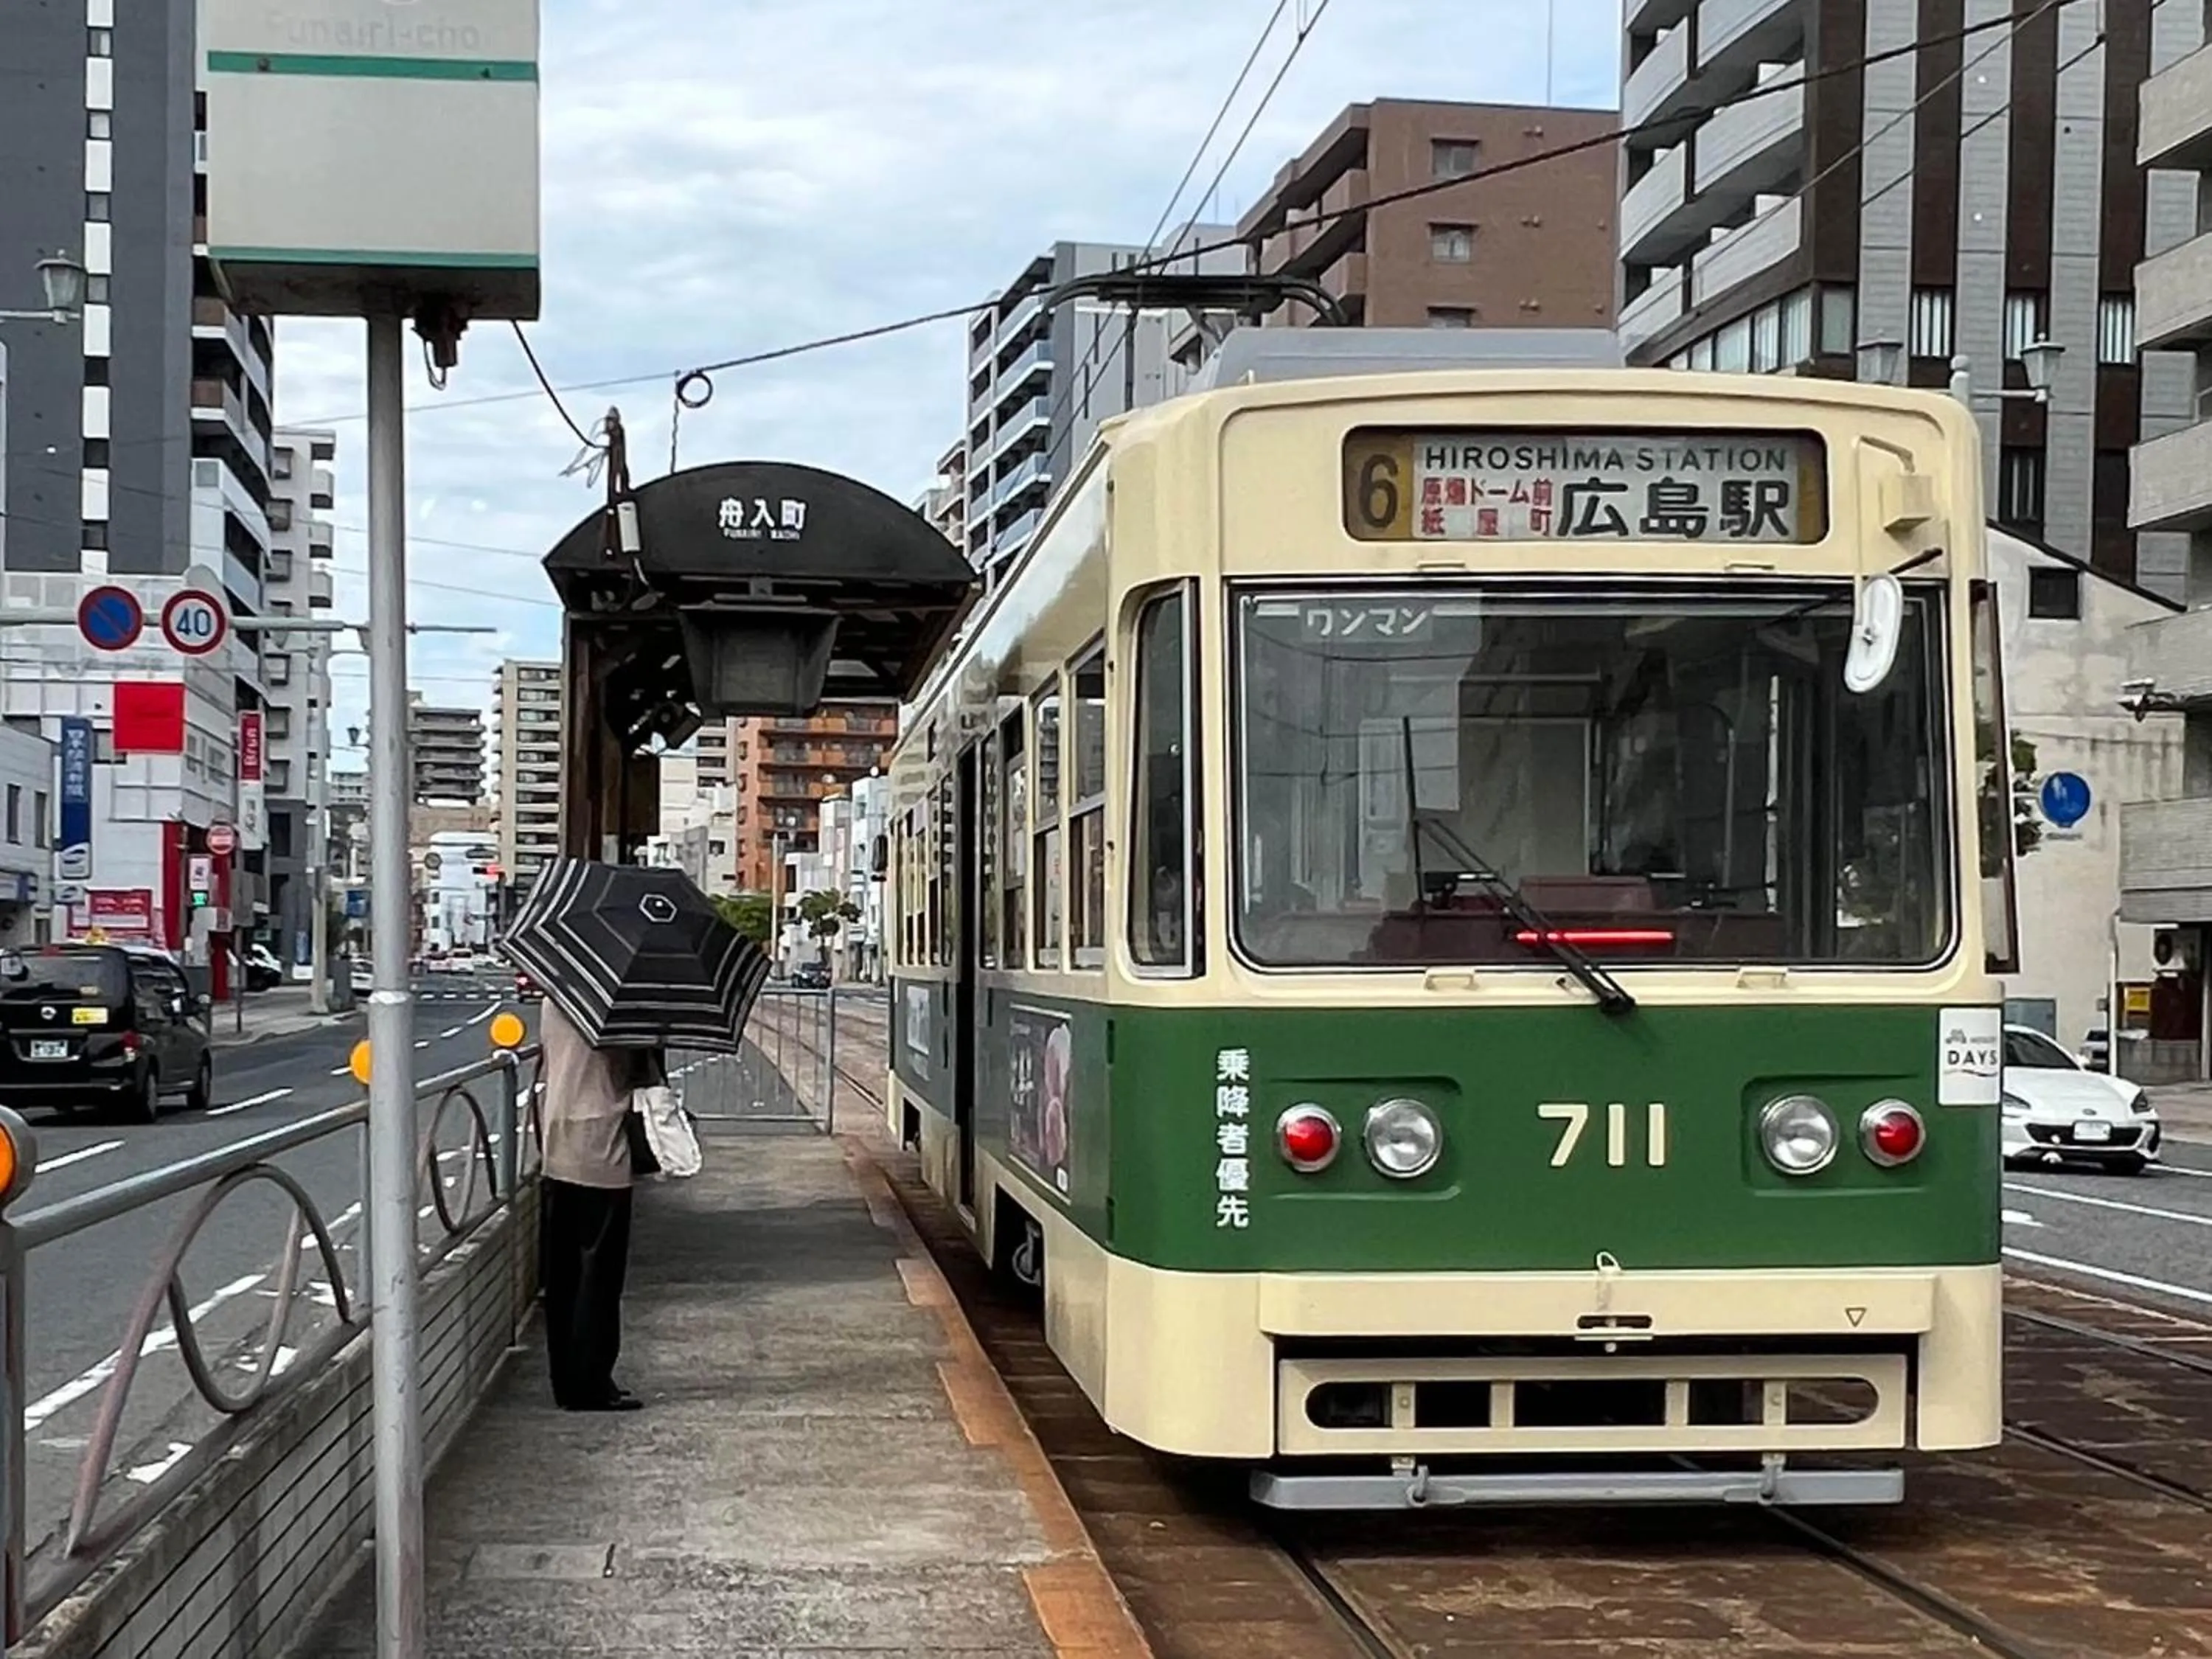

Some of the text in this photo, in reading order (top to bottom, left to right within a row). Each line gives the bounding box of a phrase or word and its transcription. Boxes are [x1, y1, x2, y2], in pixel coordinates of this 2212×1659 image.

[1425, 445, 1786, 473] HIROSHIMA STATION
[1358, 454, 1399, 529] 6
[1556, 476, 1790, 538] 広島駅
[719, 497, 806, 530] 舟入町
[175, 608, 212, 638] 40
[1307, 608, 1428, 636] ワンマン
[1947, 1048, 1998, 1066] DAYS
[1216, 1048, 1251, 1229] 乗降者優先
[1537, 1103, 1665, 1167] 711
